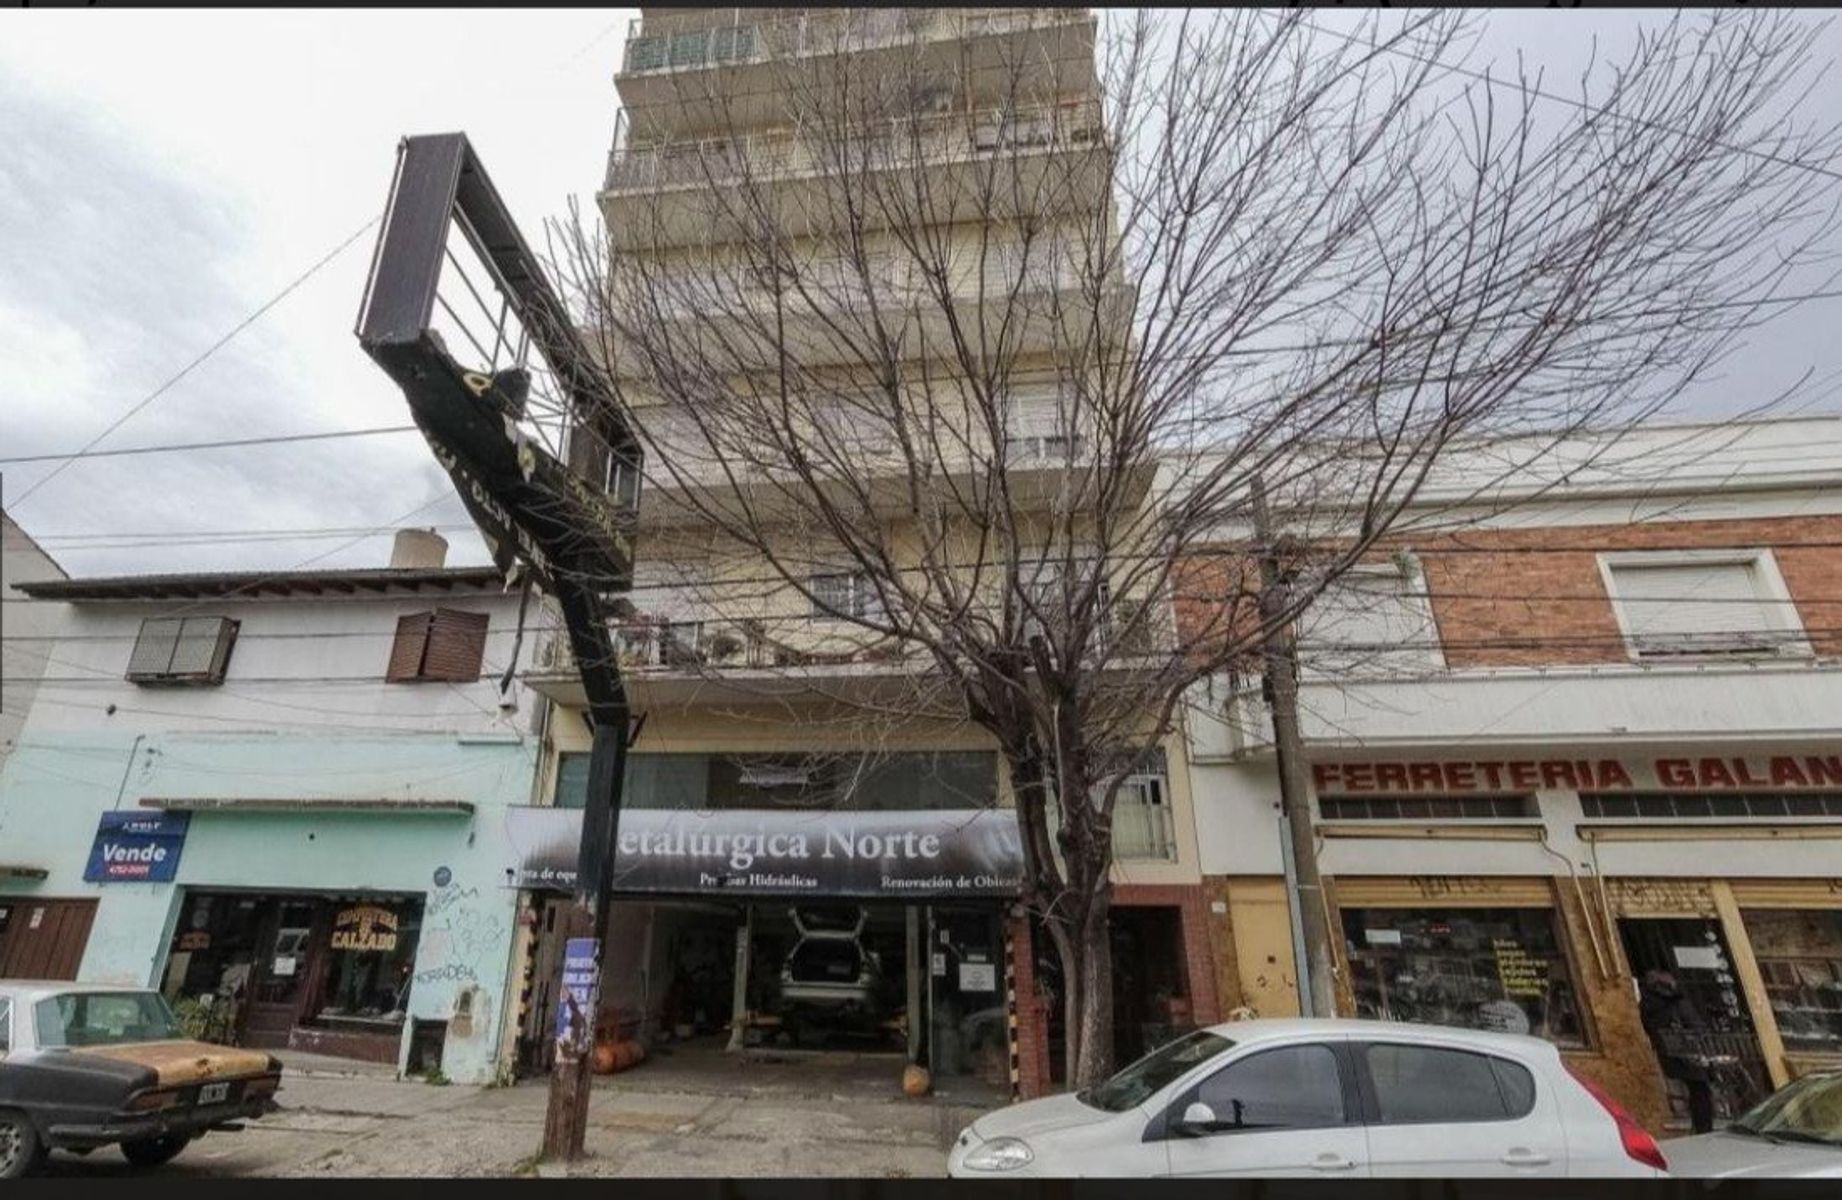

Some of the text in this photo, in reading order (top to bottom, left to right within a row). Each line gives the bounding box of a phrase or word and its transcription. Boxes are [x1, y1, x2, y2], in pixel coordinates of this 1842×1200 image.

[1312, 759, 1634, 790] FERRETERIA
[103, 842, 167, 862] Vende
[618, 823, 941, 870] etalúrgica Norte
[956, 874, 972, 888] de
[331, 931, 398, 952] CALZADO
